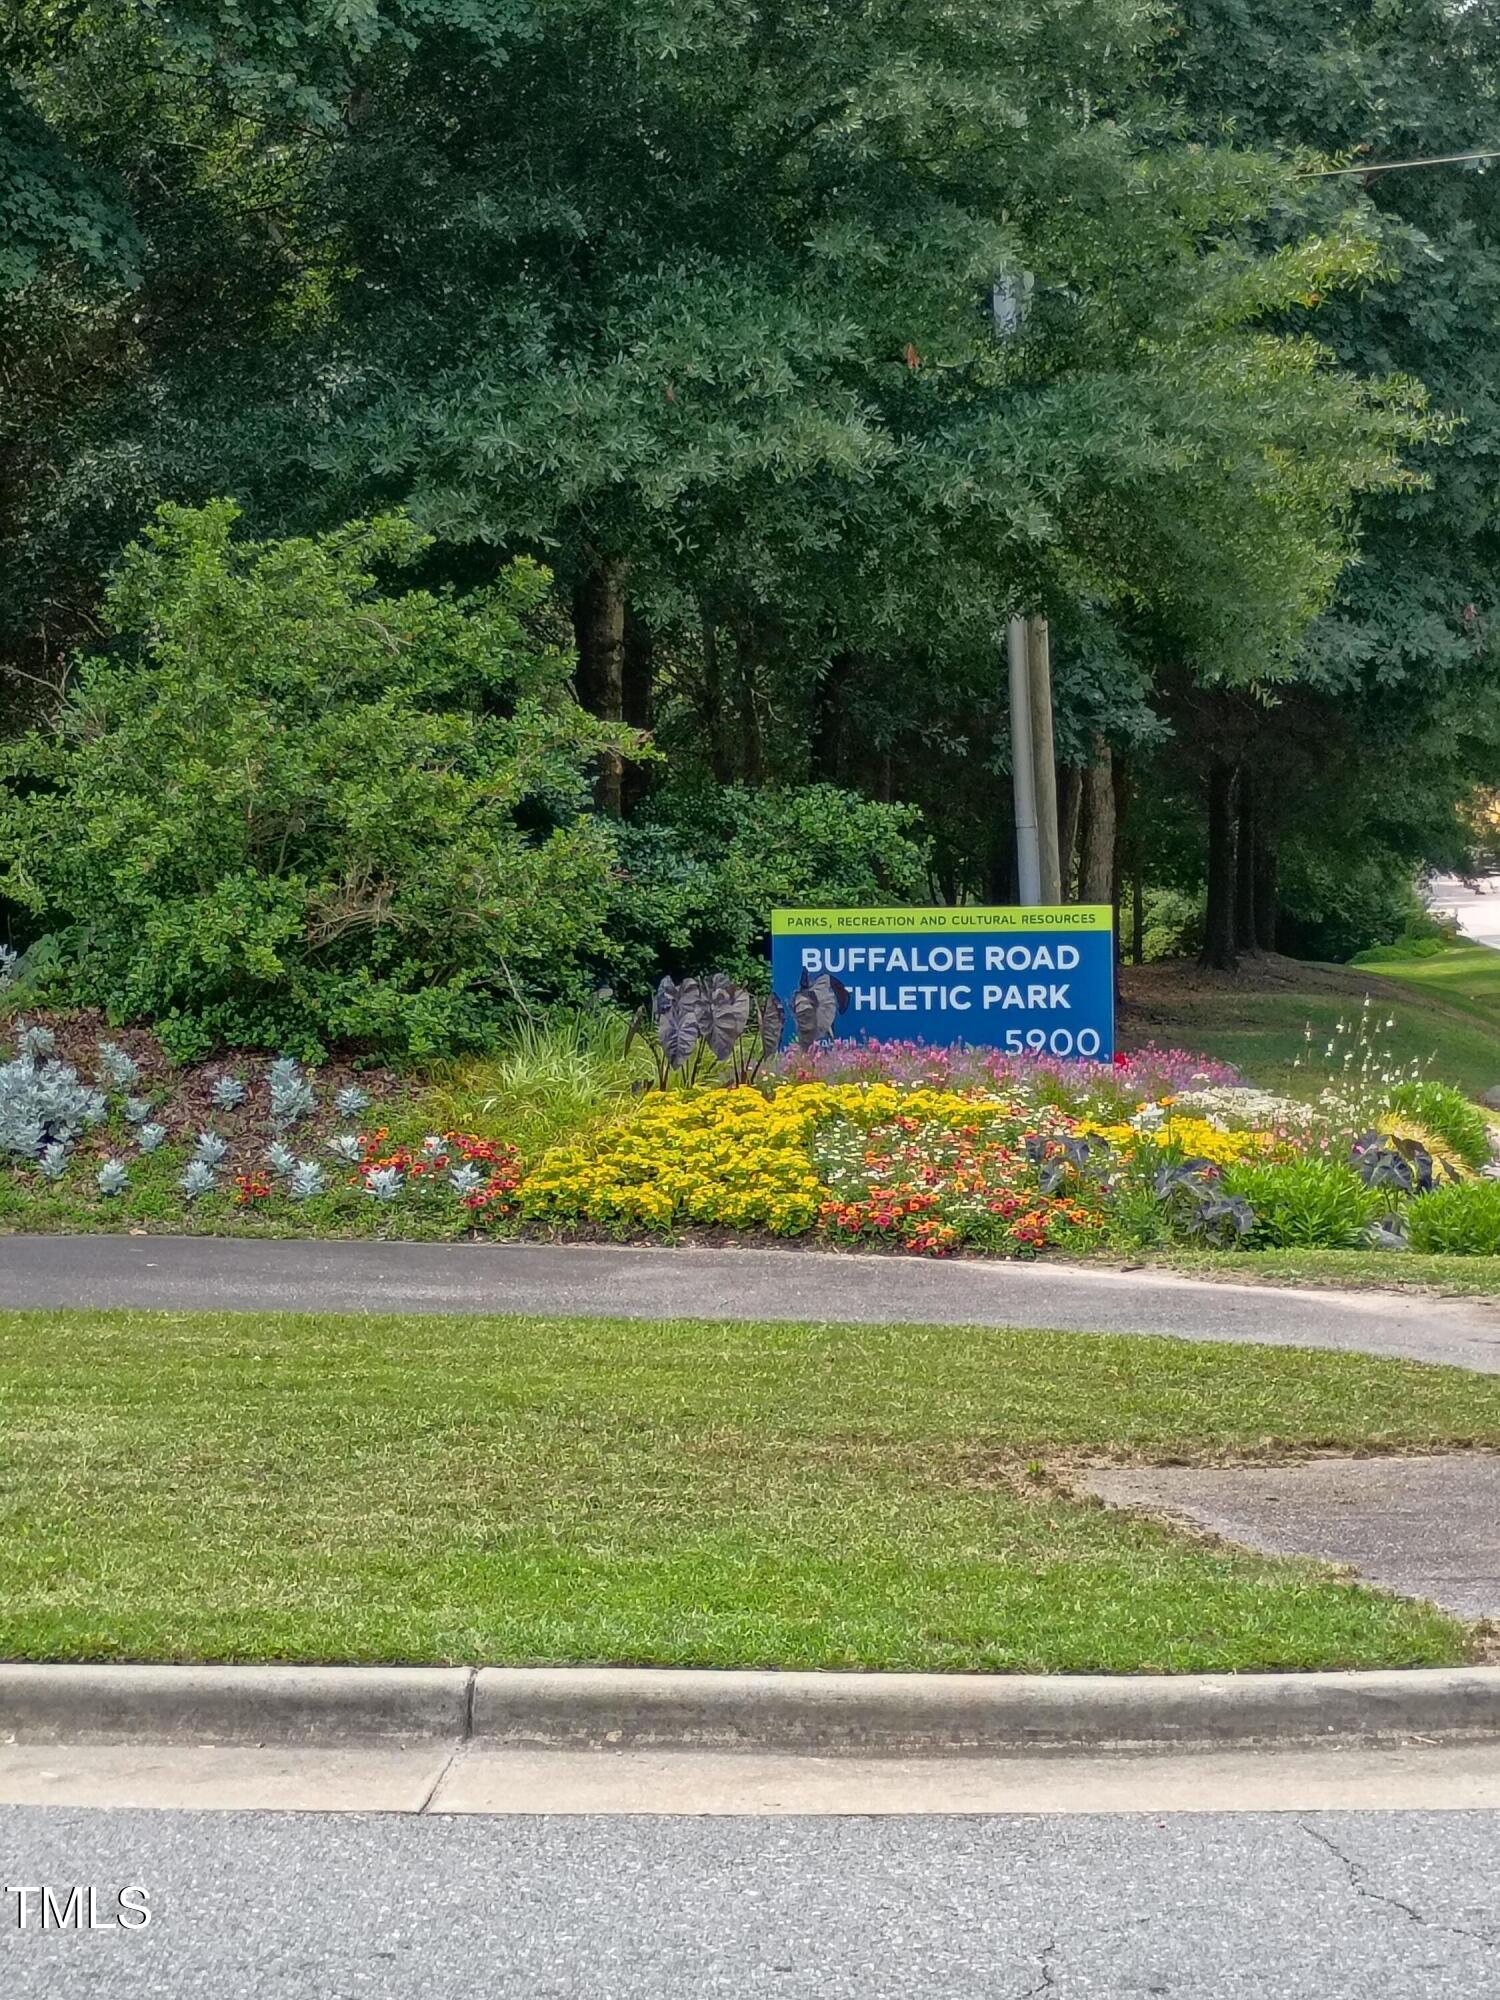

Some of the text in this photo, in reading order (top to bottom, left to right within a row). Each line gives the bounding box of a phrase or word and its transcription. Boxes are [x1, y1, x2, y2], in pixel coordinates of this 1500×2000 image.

[787, 913, 1096, 929] PARKS, RECREATION AND CULTURAL RESOURCES
[801, 945, 1080, 973] BUFFALOE ROAD
[844, 984, 1072, 1011] HLETIC PARK
[1005, 1028, 1101, 1056] 5900
